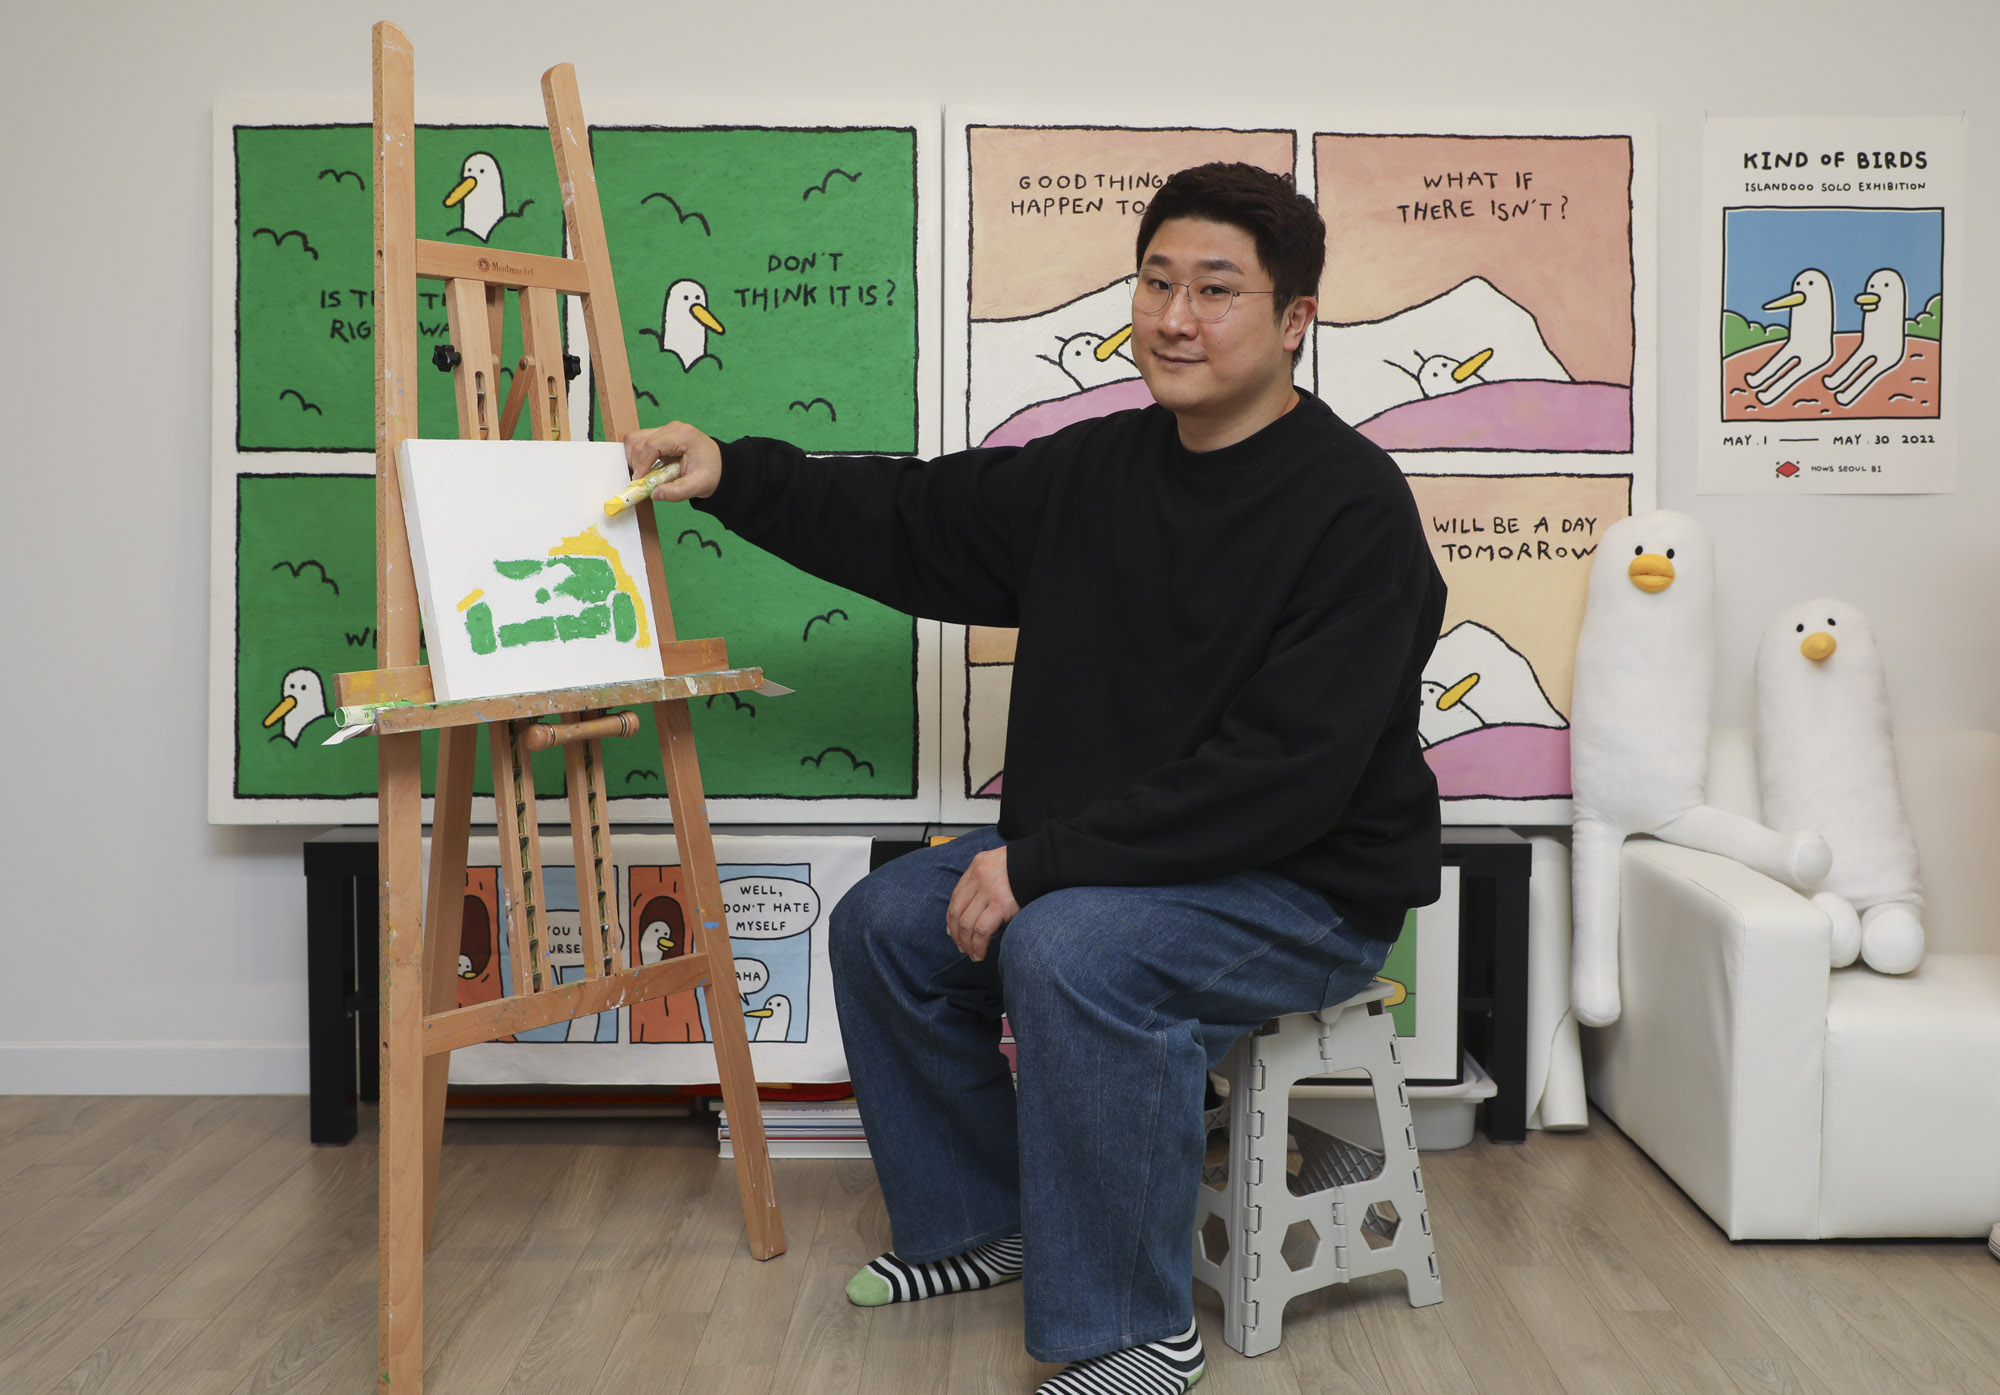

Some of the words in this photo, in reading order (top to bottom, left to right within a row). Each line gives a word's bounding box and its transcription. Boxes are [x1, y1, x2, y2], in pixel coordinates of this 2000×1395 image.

[1743, 151, 1809, 170] KIND
[1856, 151, 1928, 170] BIRDS
[1019, 173, 1087, 190] GOOD
[1094, 172, 1174, 191] THING
[1423, 171, 1498, 190] WHAT
[1515, 171, 1533, 190] IF
[1821, 182, 1852, 193] SOLO
[1858, 181, 1926, 192] EXHIBITION
[1011, 197, 1104, 217] HAPPEN
[1397, 199, 1475, 223] THERE
[768, 252, 843, 274] DON'T
[320, 289, 342, 309] IS
[734, 283, 818, 312] THINK
[830, 285, 851, 307] IT
[330, 319, 374, 343] RIG
[1902, 435, 1935, 444] 2022
[1838, 465, 1867, 473] SEOUL
[1433, 516, 1485, 534] WILL
[1493, 516, 1519, 534] BE
[1533, 516, 1549, 534] A
[1562, 517, 1597, 537] DAY
[1441, 540, 1598, 562] TOMORROW
[740, 885, 783, 897] WELL,
[724, 903, 765, 913] DON'T
[773, 903, 810, 913] HATE
[736, 921, 786, 931] MYSELF
[549, 944, 580, 954] URSE
[736, 972, 761, 981] AHA
